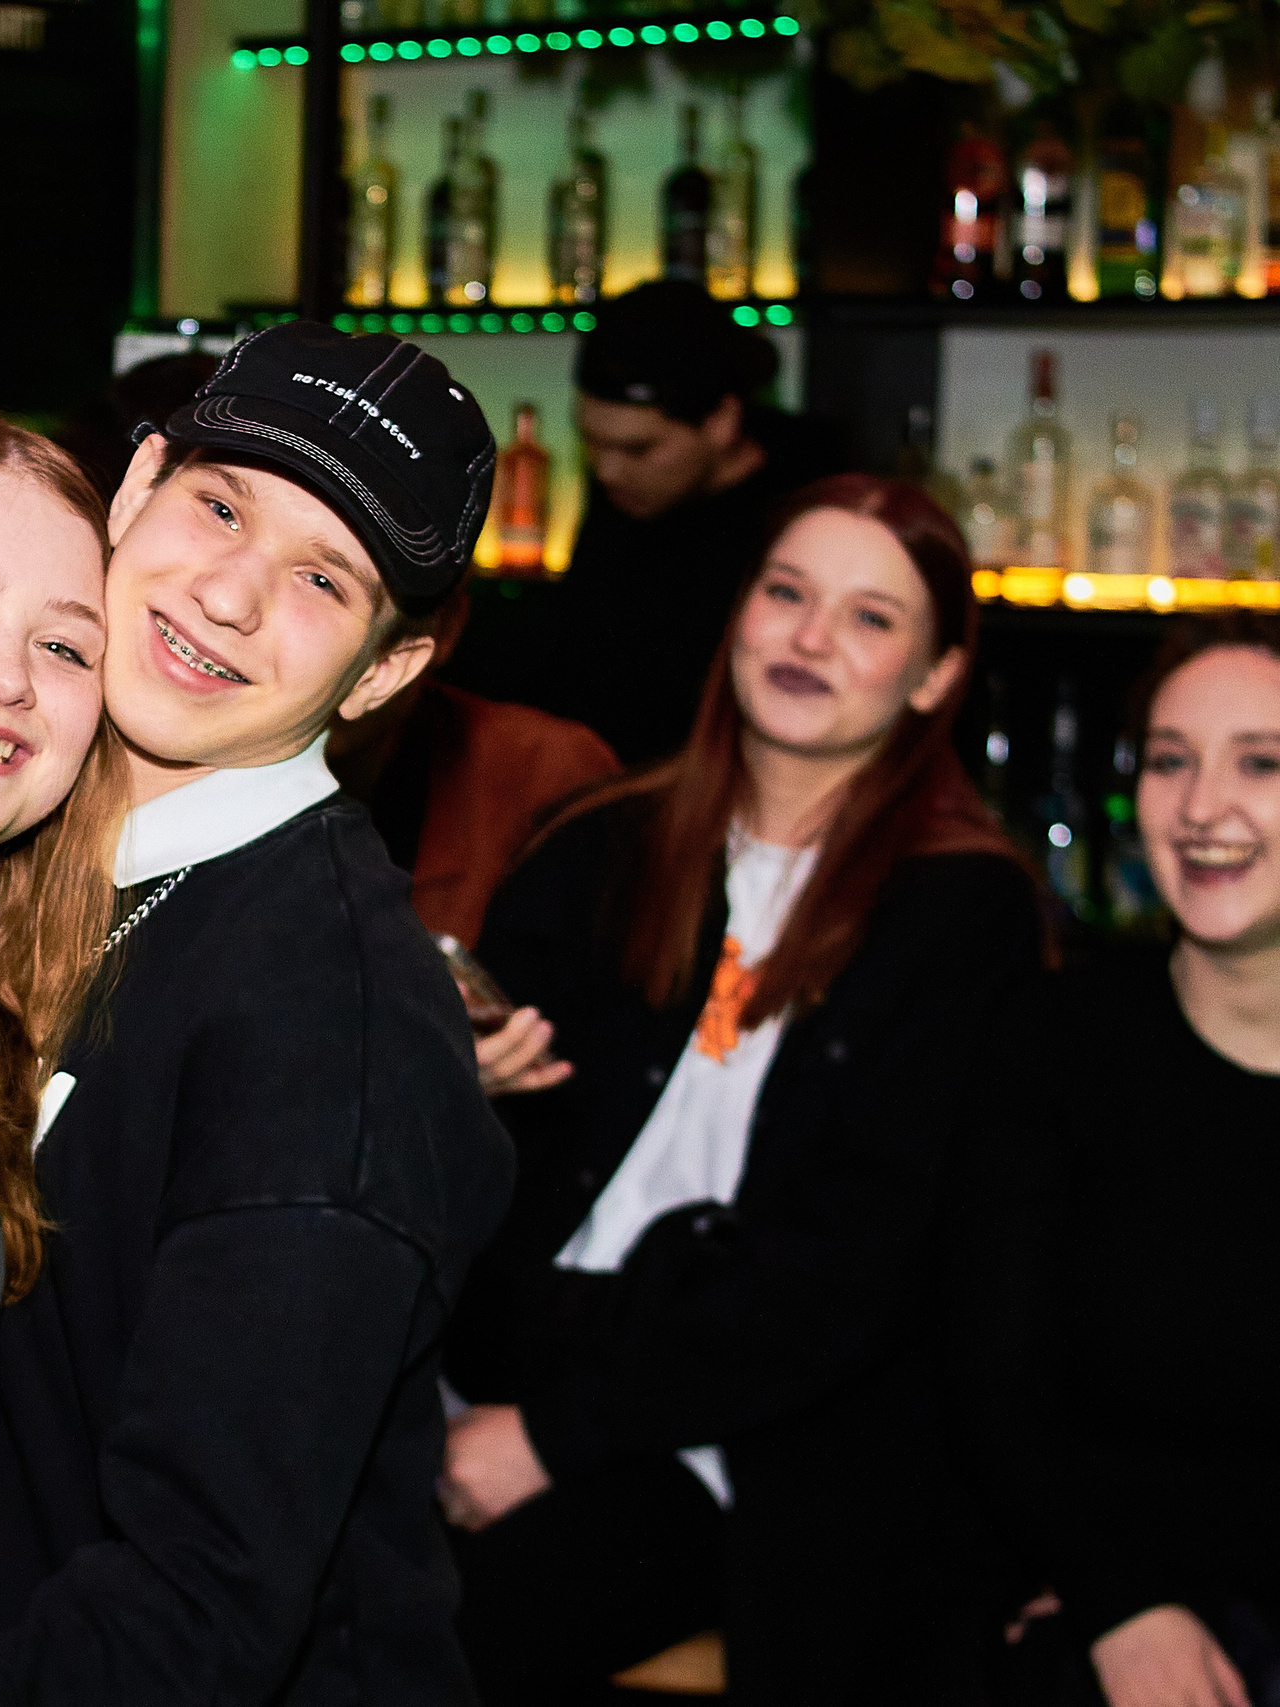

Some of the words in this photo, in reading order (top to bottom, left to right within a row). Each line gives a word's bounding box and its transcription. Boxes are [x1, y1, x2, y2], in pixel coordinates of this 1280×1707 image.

[292, 372, 314, 384] no
[315, 378, 358, 401] risk
[358, 398, 380, 418] no
[380, 417, 422, 460] story
